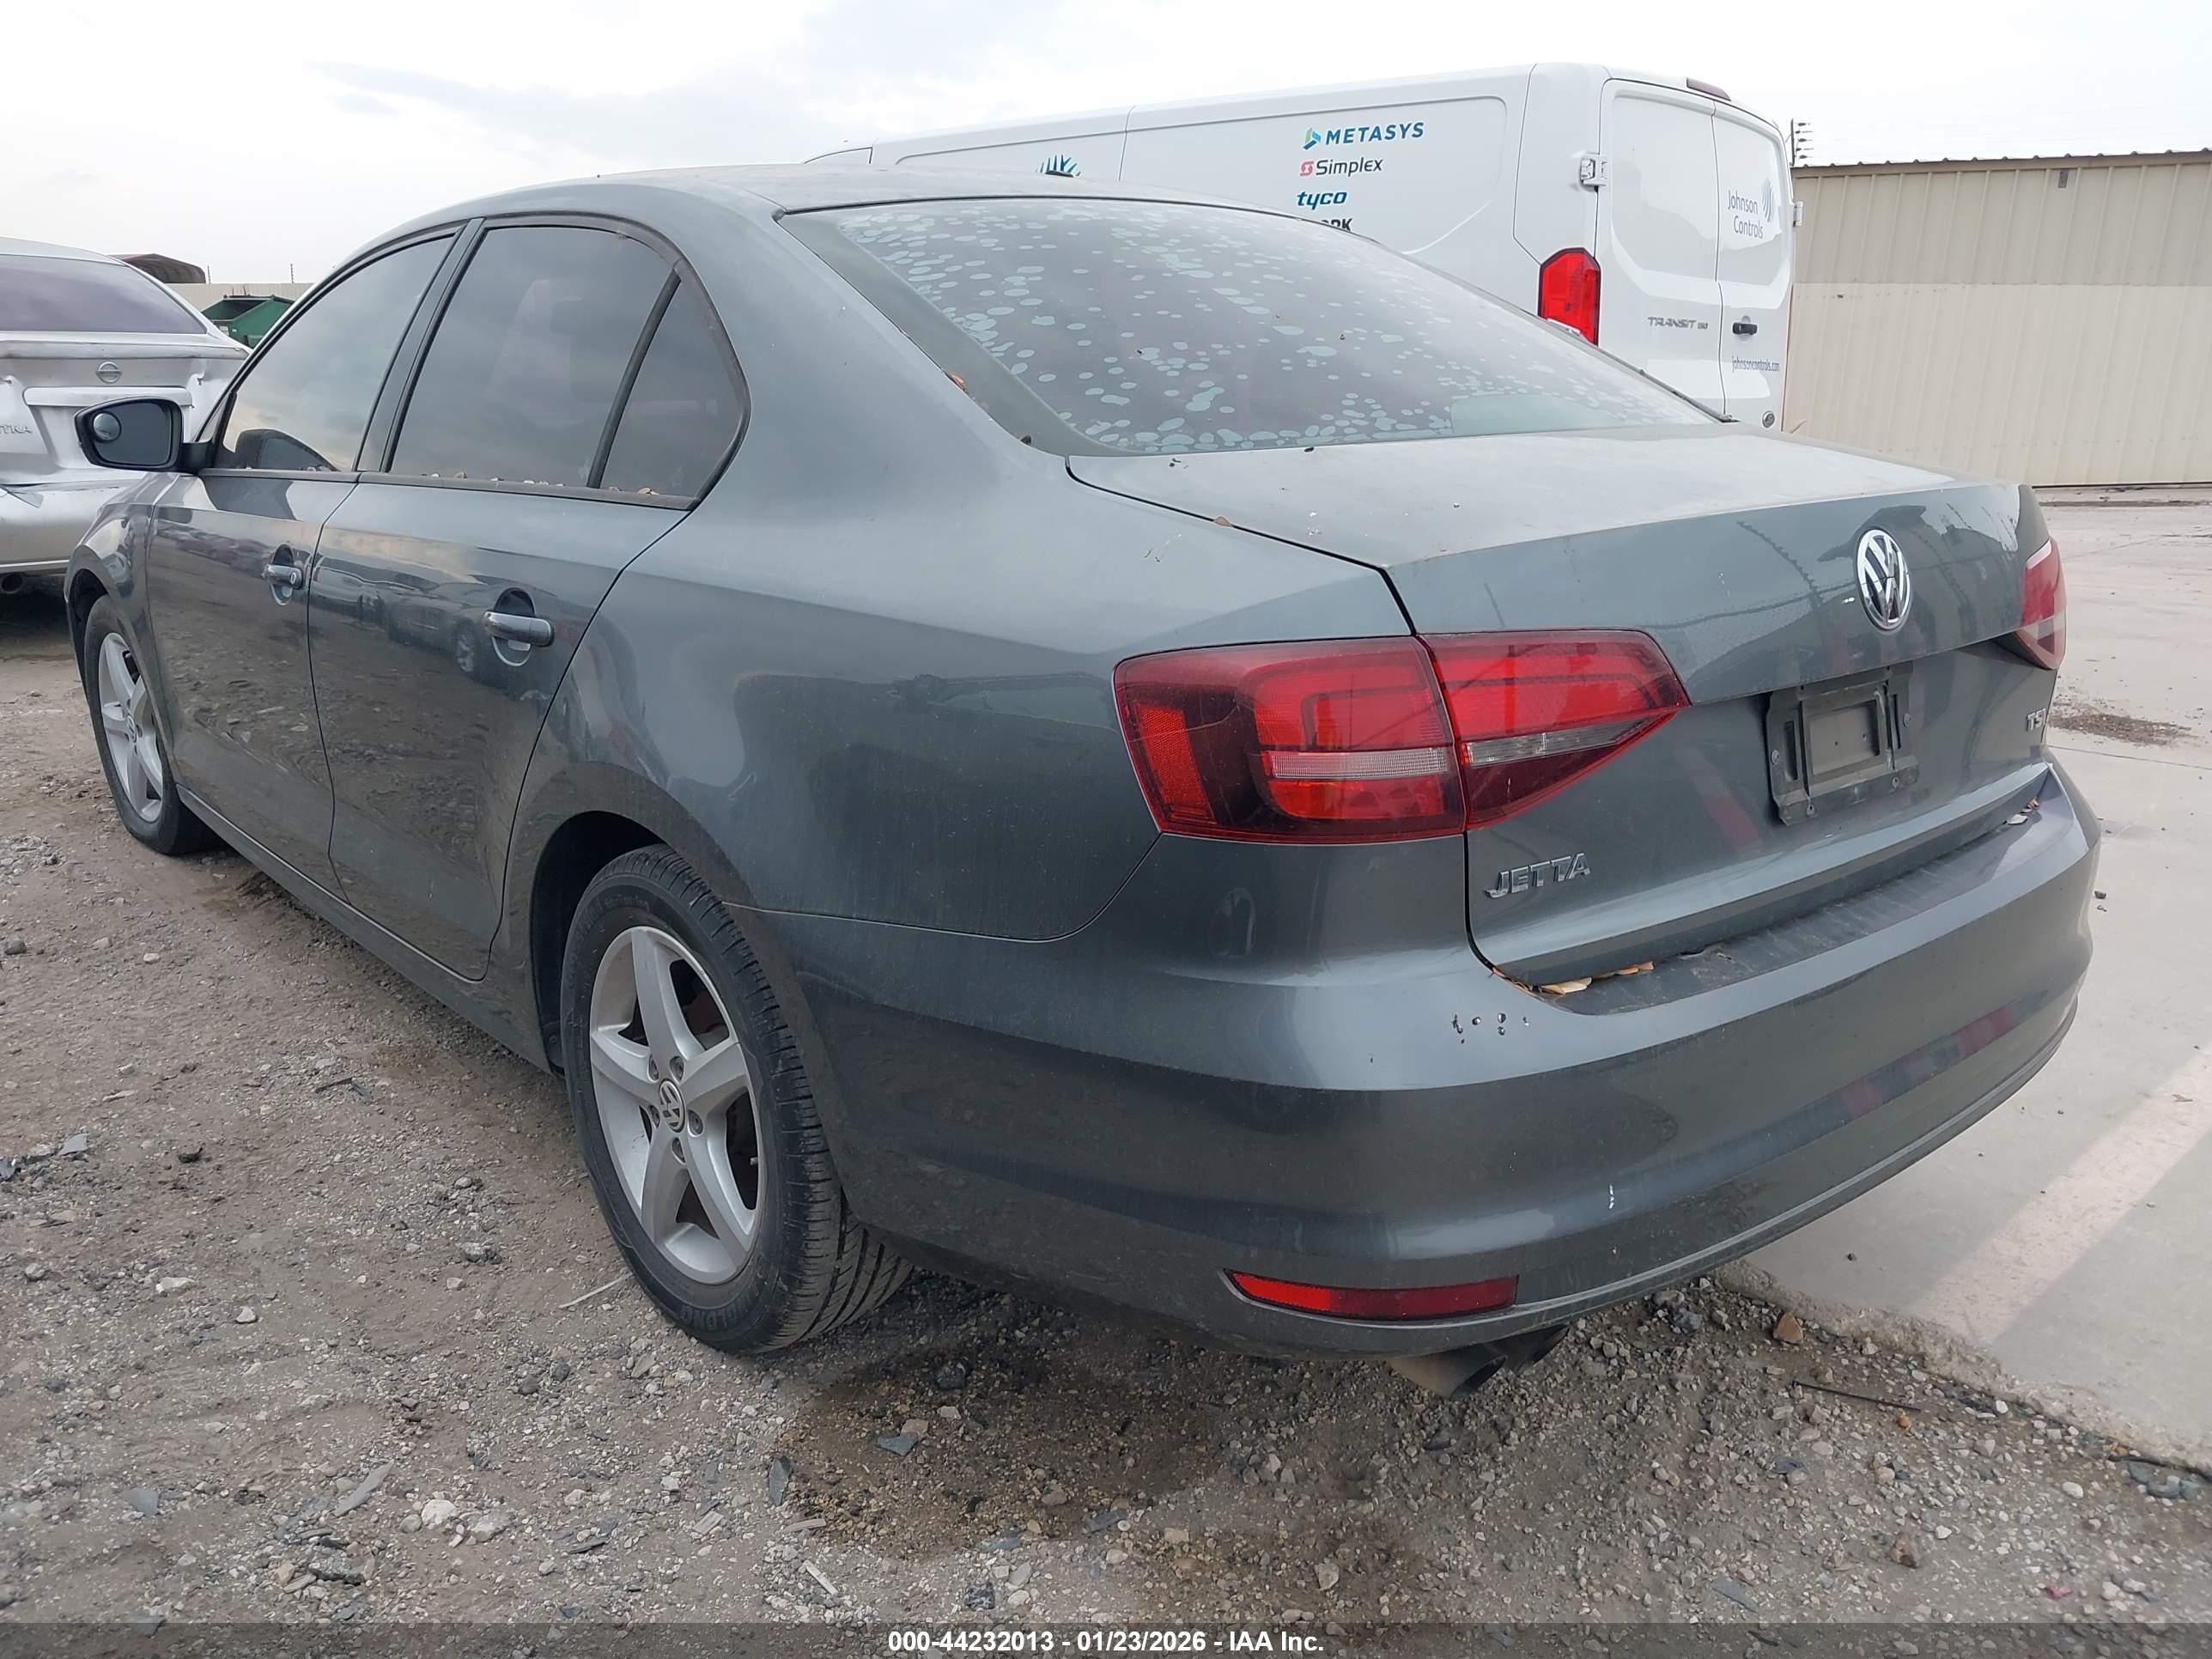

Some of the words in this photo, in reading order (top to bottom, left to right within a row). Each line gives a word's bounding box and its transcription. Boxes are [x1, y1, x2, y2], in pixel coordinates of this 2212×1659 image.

[1326, 123, 1424, 145] METASYS
[1316, 157, 1382, 177] Simplex
[1297, 191, 1347, 210] tyco
[1728, 190, 1758, 215] Johnson
[1734, 216, 1763, 239] Controls
[1485, 852, 1590, 899] JETTA
